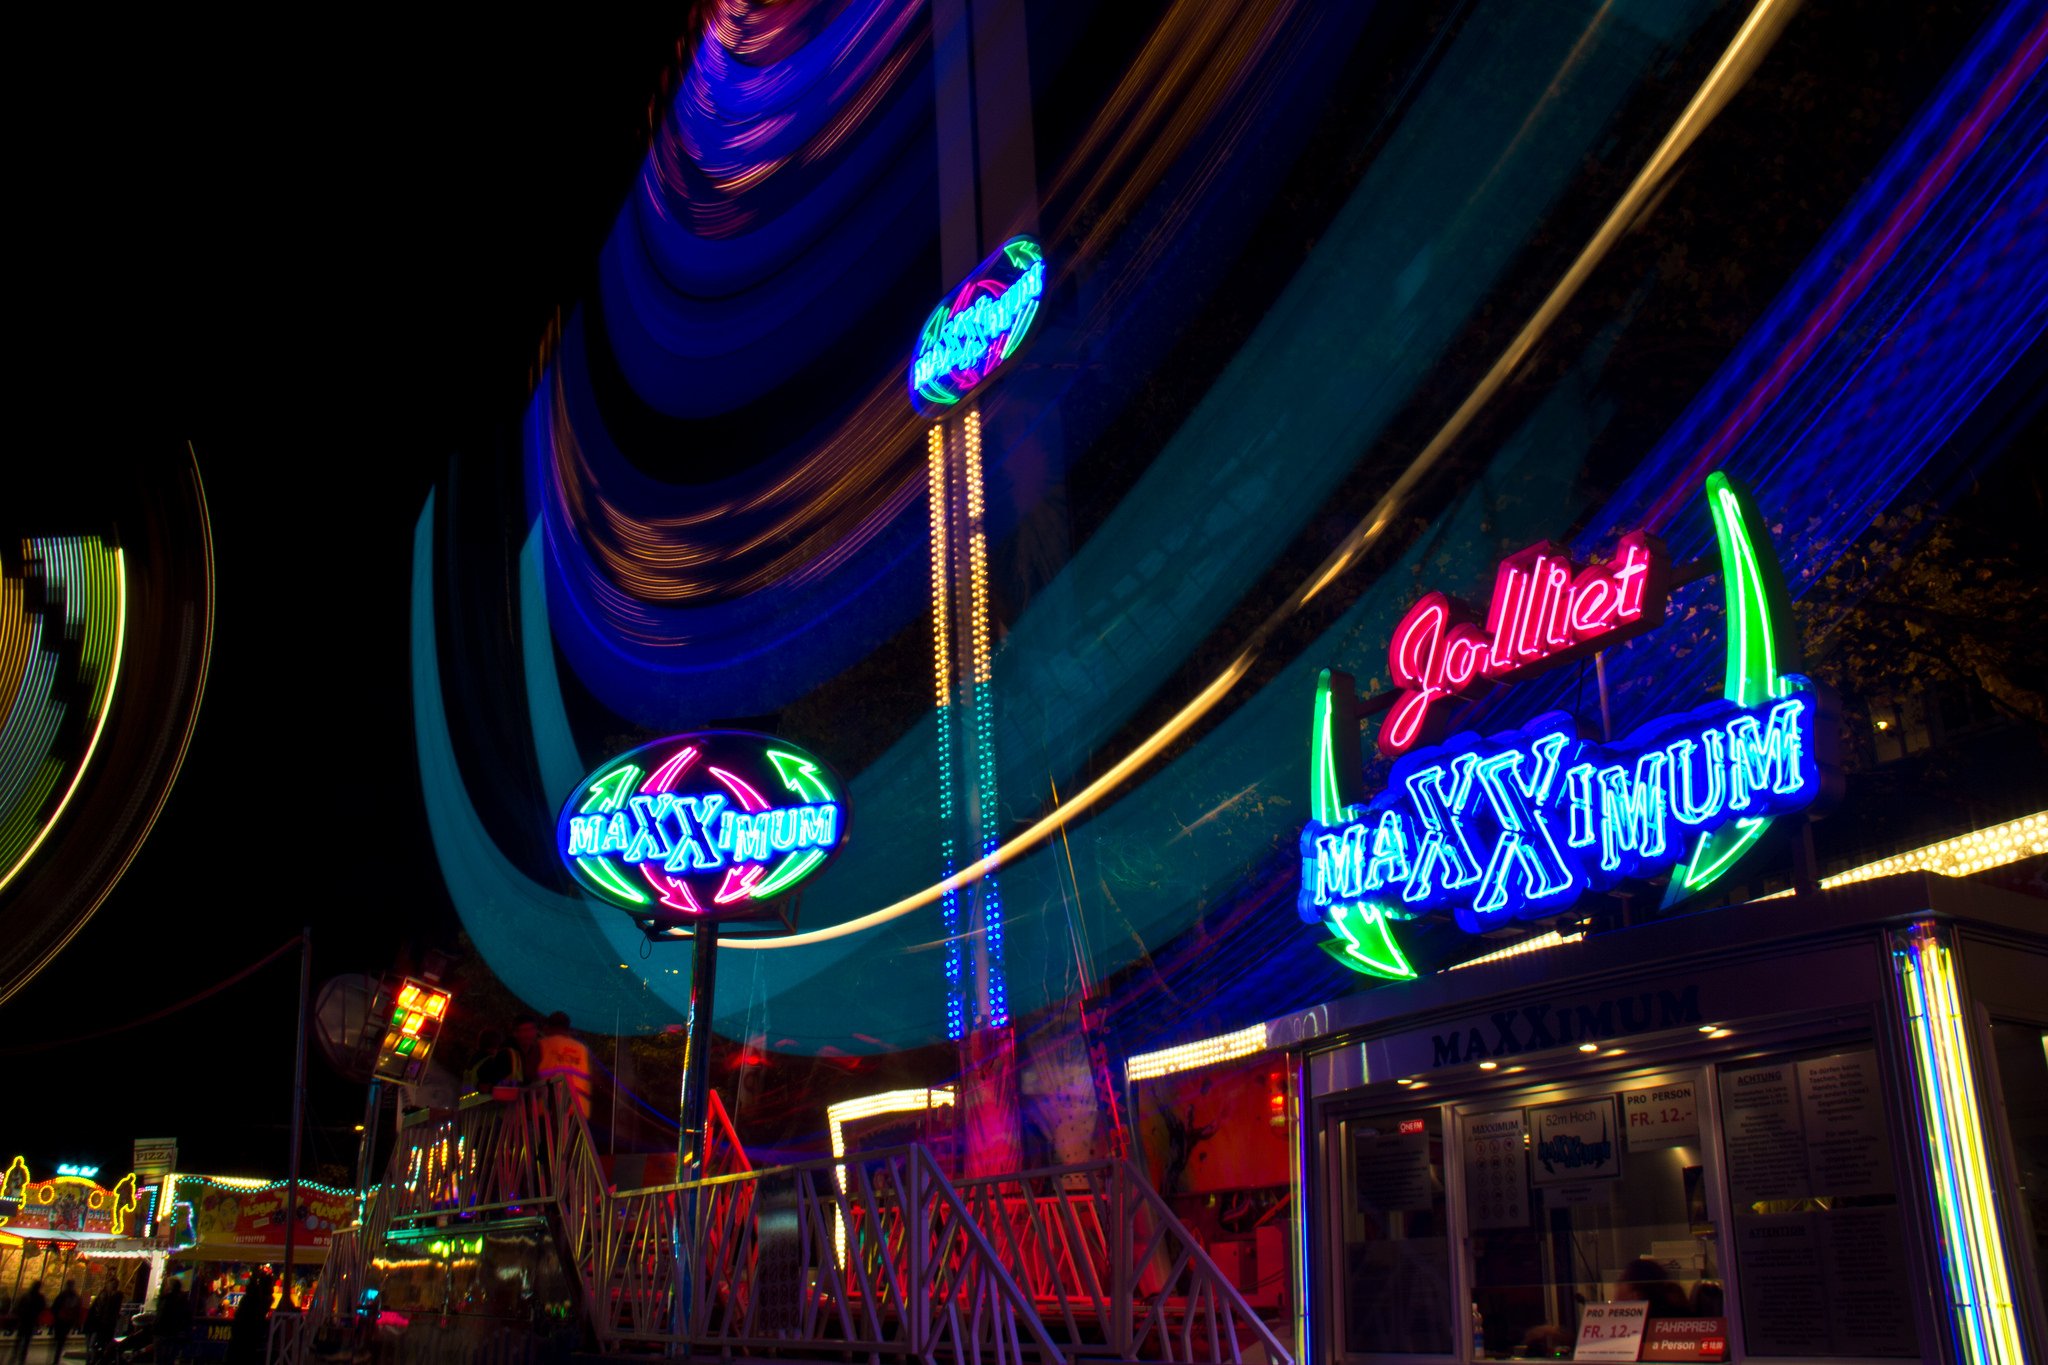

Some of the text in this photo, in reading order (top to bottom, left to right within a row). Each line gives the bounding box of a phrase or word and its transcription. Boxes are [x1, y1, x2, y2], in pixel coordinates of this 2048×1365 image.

[1387, 540, 1653, 750] Jolliet
[1314, 699, 1805, 913] MAXXIMUM
[566, 793, 838, 874] MAXXIMUM
[1432, 985, 1701, 1067] MAXXIMUM
[1737, 1071, 1783, 1085] ACHTUNG
[1627, 1088, 1692, 1105] PRO PERSON
[1545, 1109, 1597, 1127] 52m Hoch
[1630, 1108, 1693, 1127] FR. 12.-
[1472, 1120, 1519, 1135] MAXXIMUM
[136, 1151, 172, 1161] PIZZA
[1586, 1308, 1643, 1318] PRO PERSON
[1582, 1324, 1639, 1339] FR. 12.-
[1655, 1320, 1718, 1334] FAHRPREIS
[1661, 1340, 1695, 1352] Person
